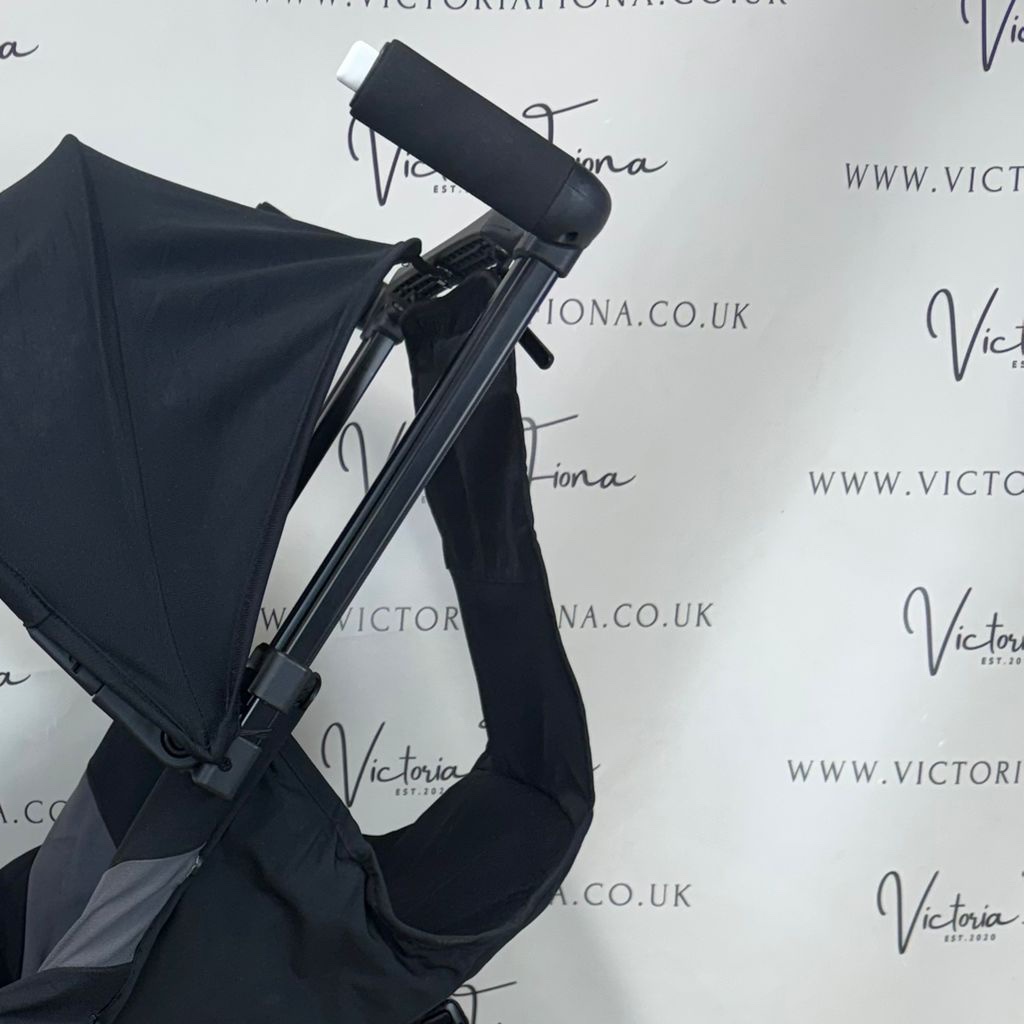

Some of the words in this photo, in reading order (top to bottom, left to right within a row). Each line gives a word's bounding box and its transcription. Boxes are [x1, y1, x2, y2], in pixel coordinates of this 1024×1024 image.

[530, 298, 750, 330] IONA.CO.UK
[321, 721, 470, 807] Victoria
[395, 787, 446, 797] EST.202
[876, 870, 1019, 955] Victoria
[944, 933, 996, 942] EST.2020
